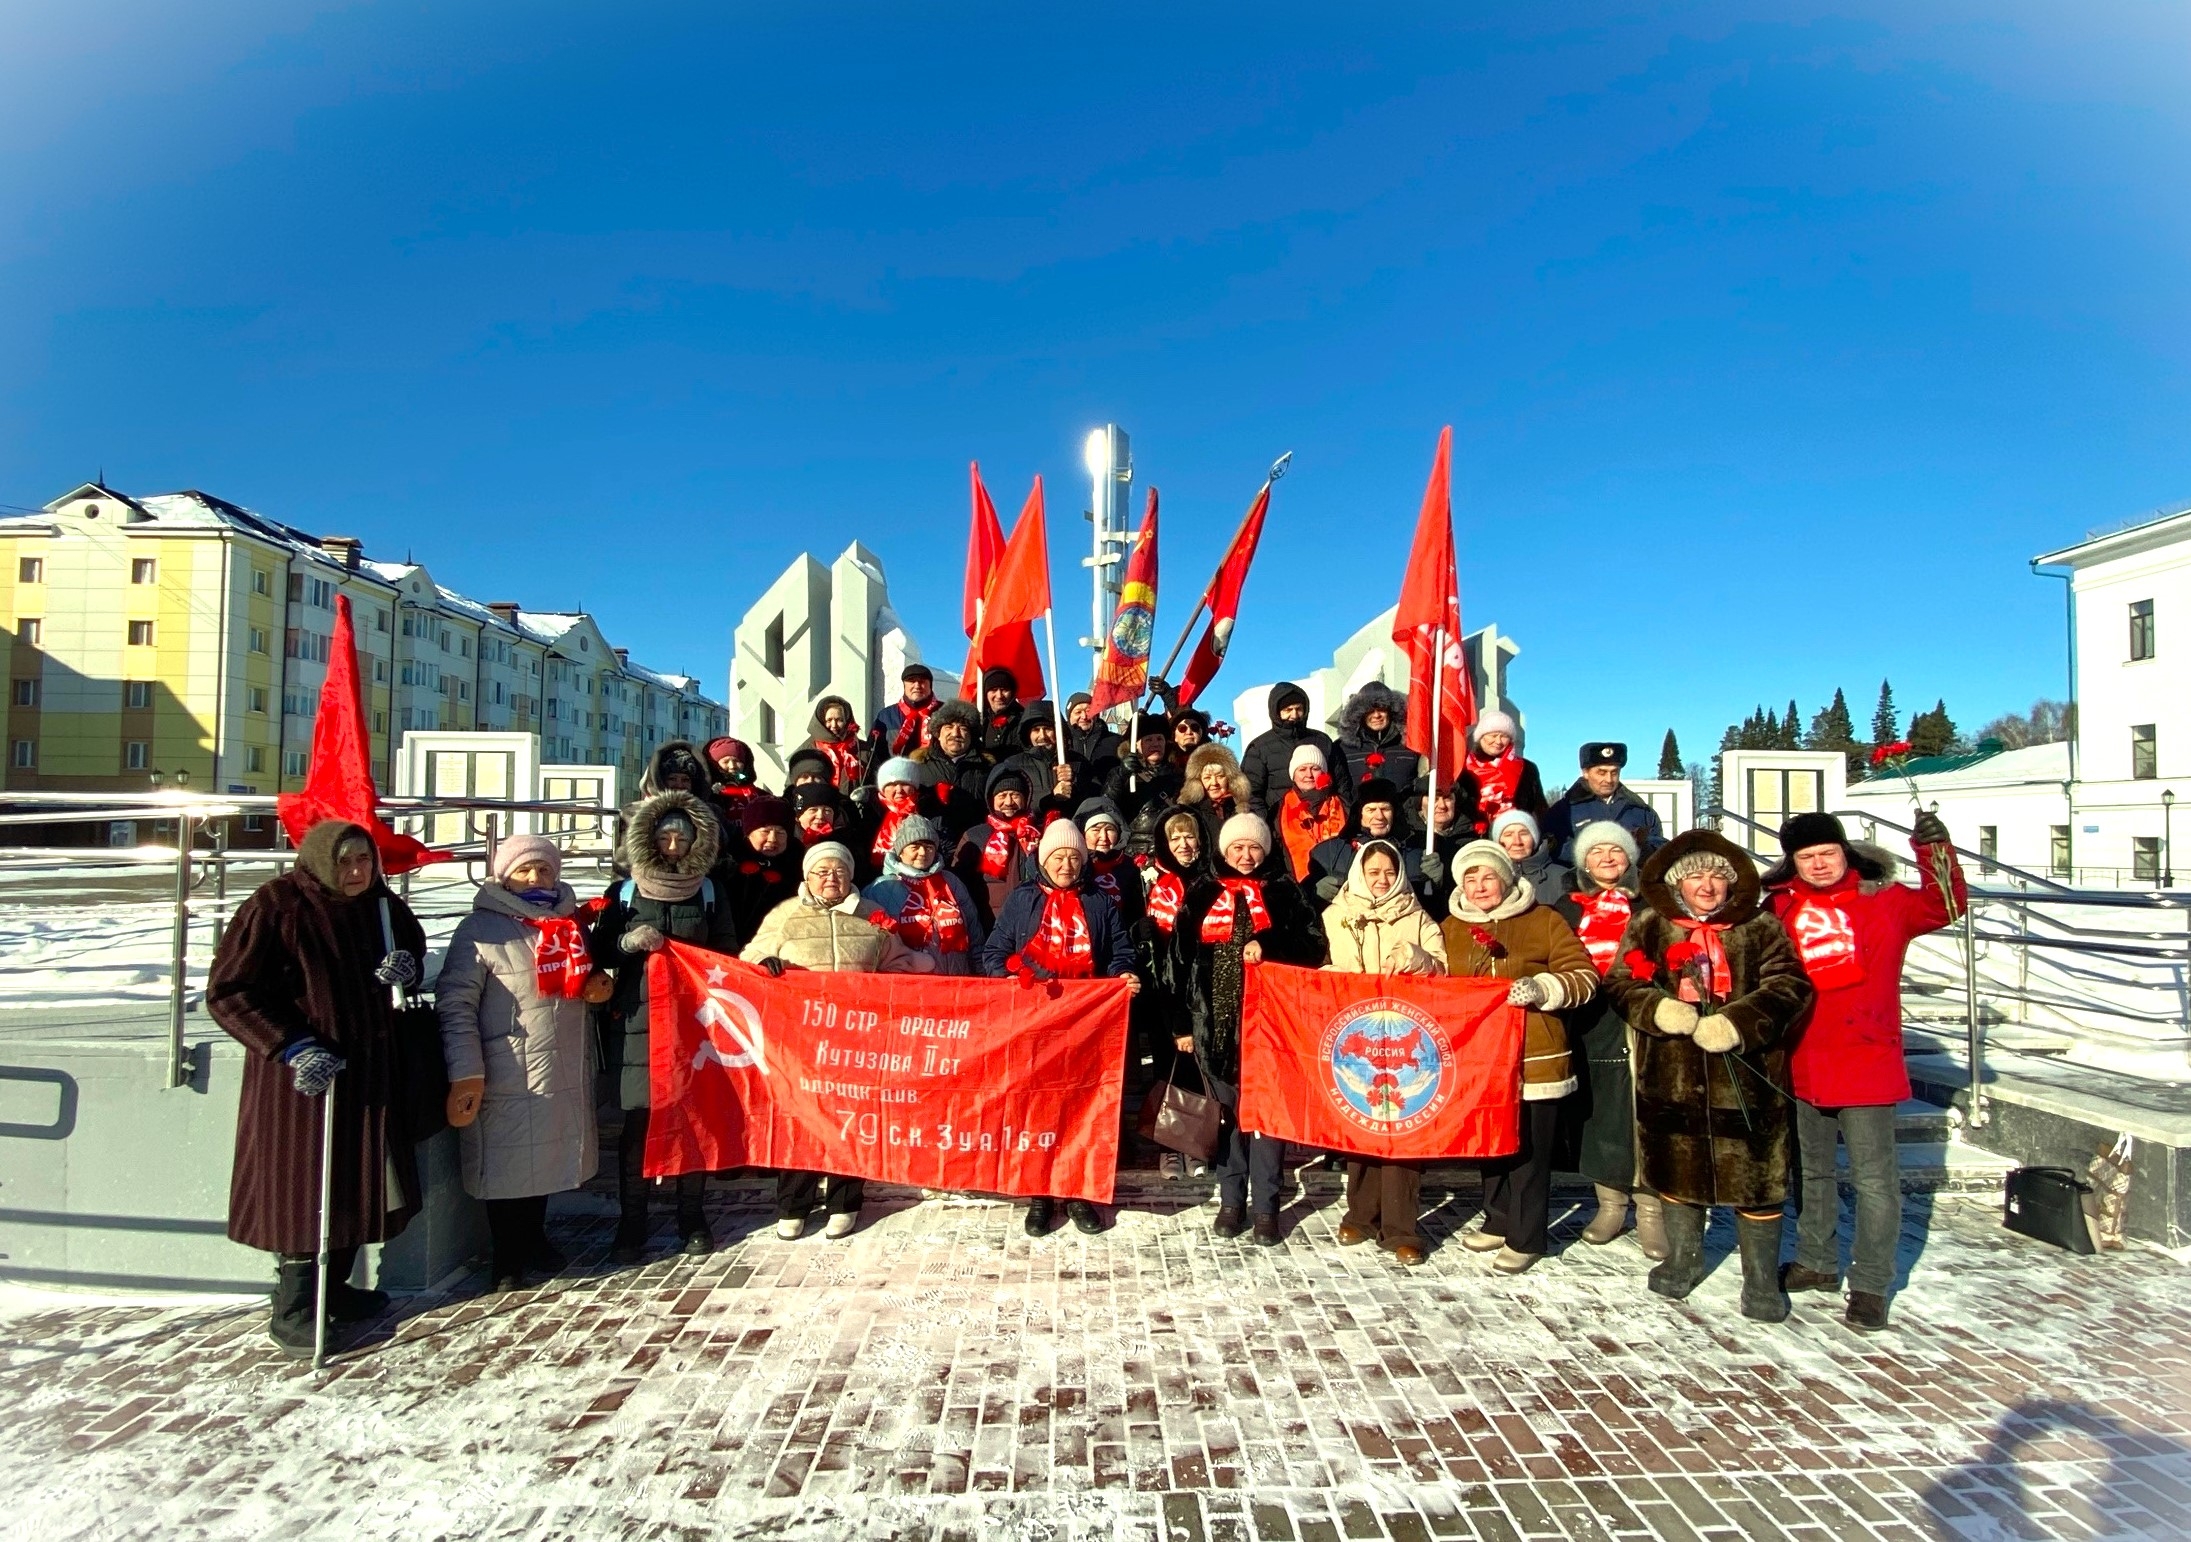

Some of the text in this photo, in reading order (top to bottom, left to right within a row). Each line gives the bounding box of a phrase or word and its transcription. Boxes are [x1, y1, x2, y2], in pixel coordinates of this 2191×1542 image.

[901, 914, 931, 924] КПРФ
[938, 917, 964, 928] КПРФ
[1203, 915, 1231, 924] КПРФ
[802, 999, 837, 1028] 150
[900, 1015, 970, 1040] ОРДЕНА
[1321, 1000, 1453, 1068] ВСЕРОССИЙСКИЙ ЖЕНСКИЙ СОЮЗ
[1365, 1047, 1406, 1057] РОССИЯ
[1330, 1087, 1445, 1132] НАДЕЖДА РОССИИ
[836, 1109, 878, 1146] 79
